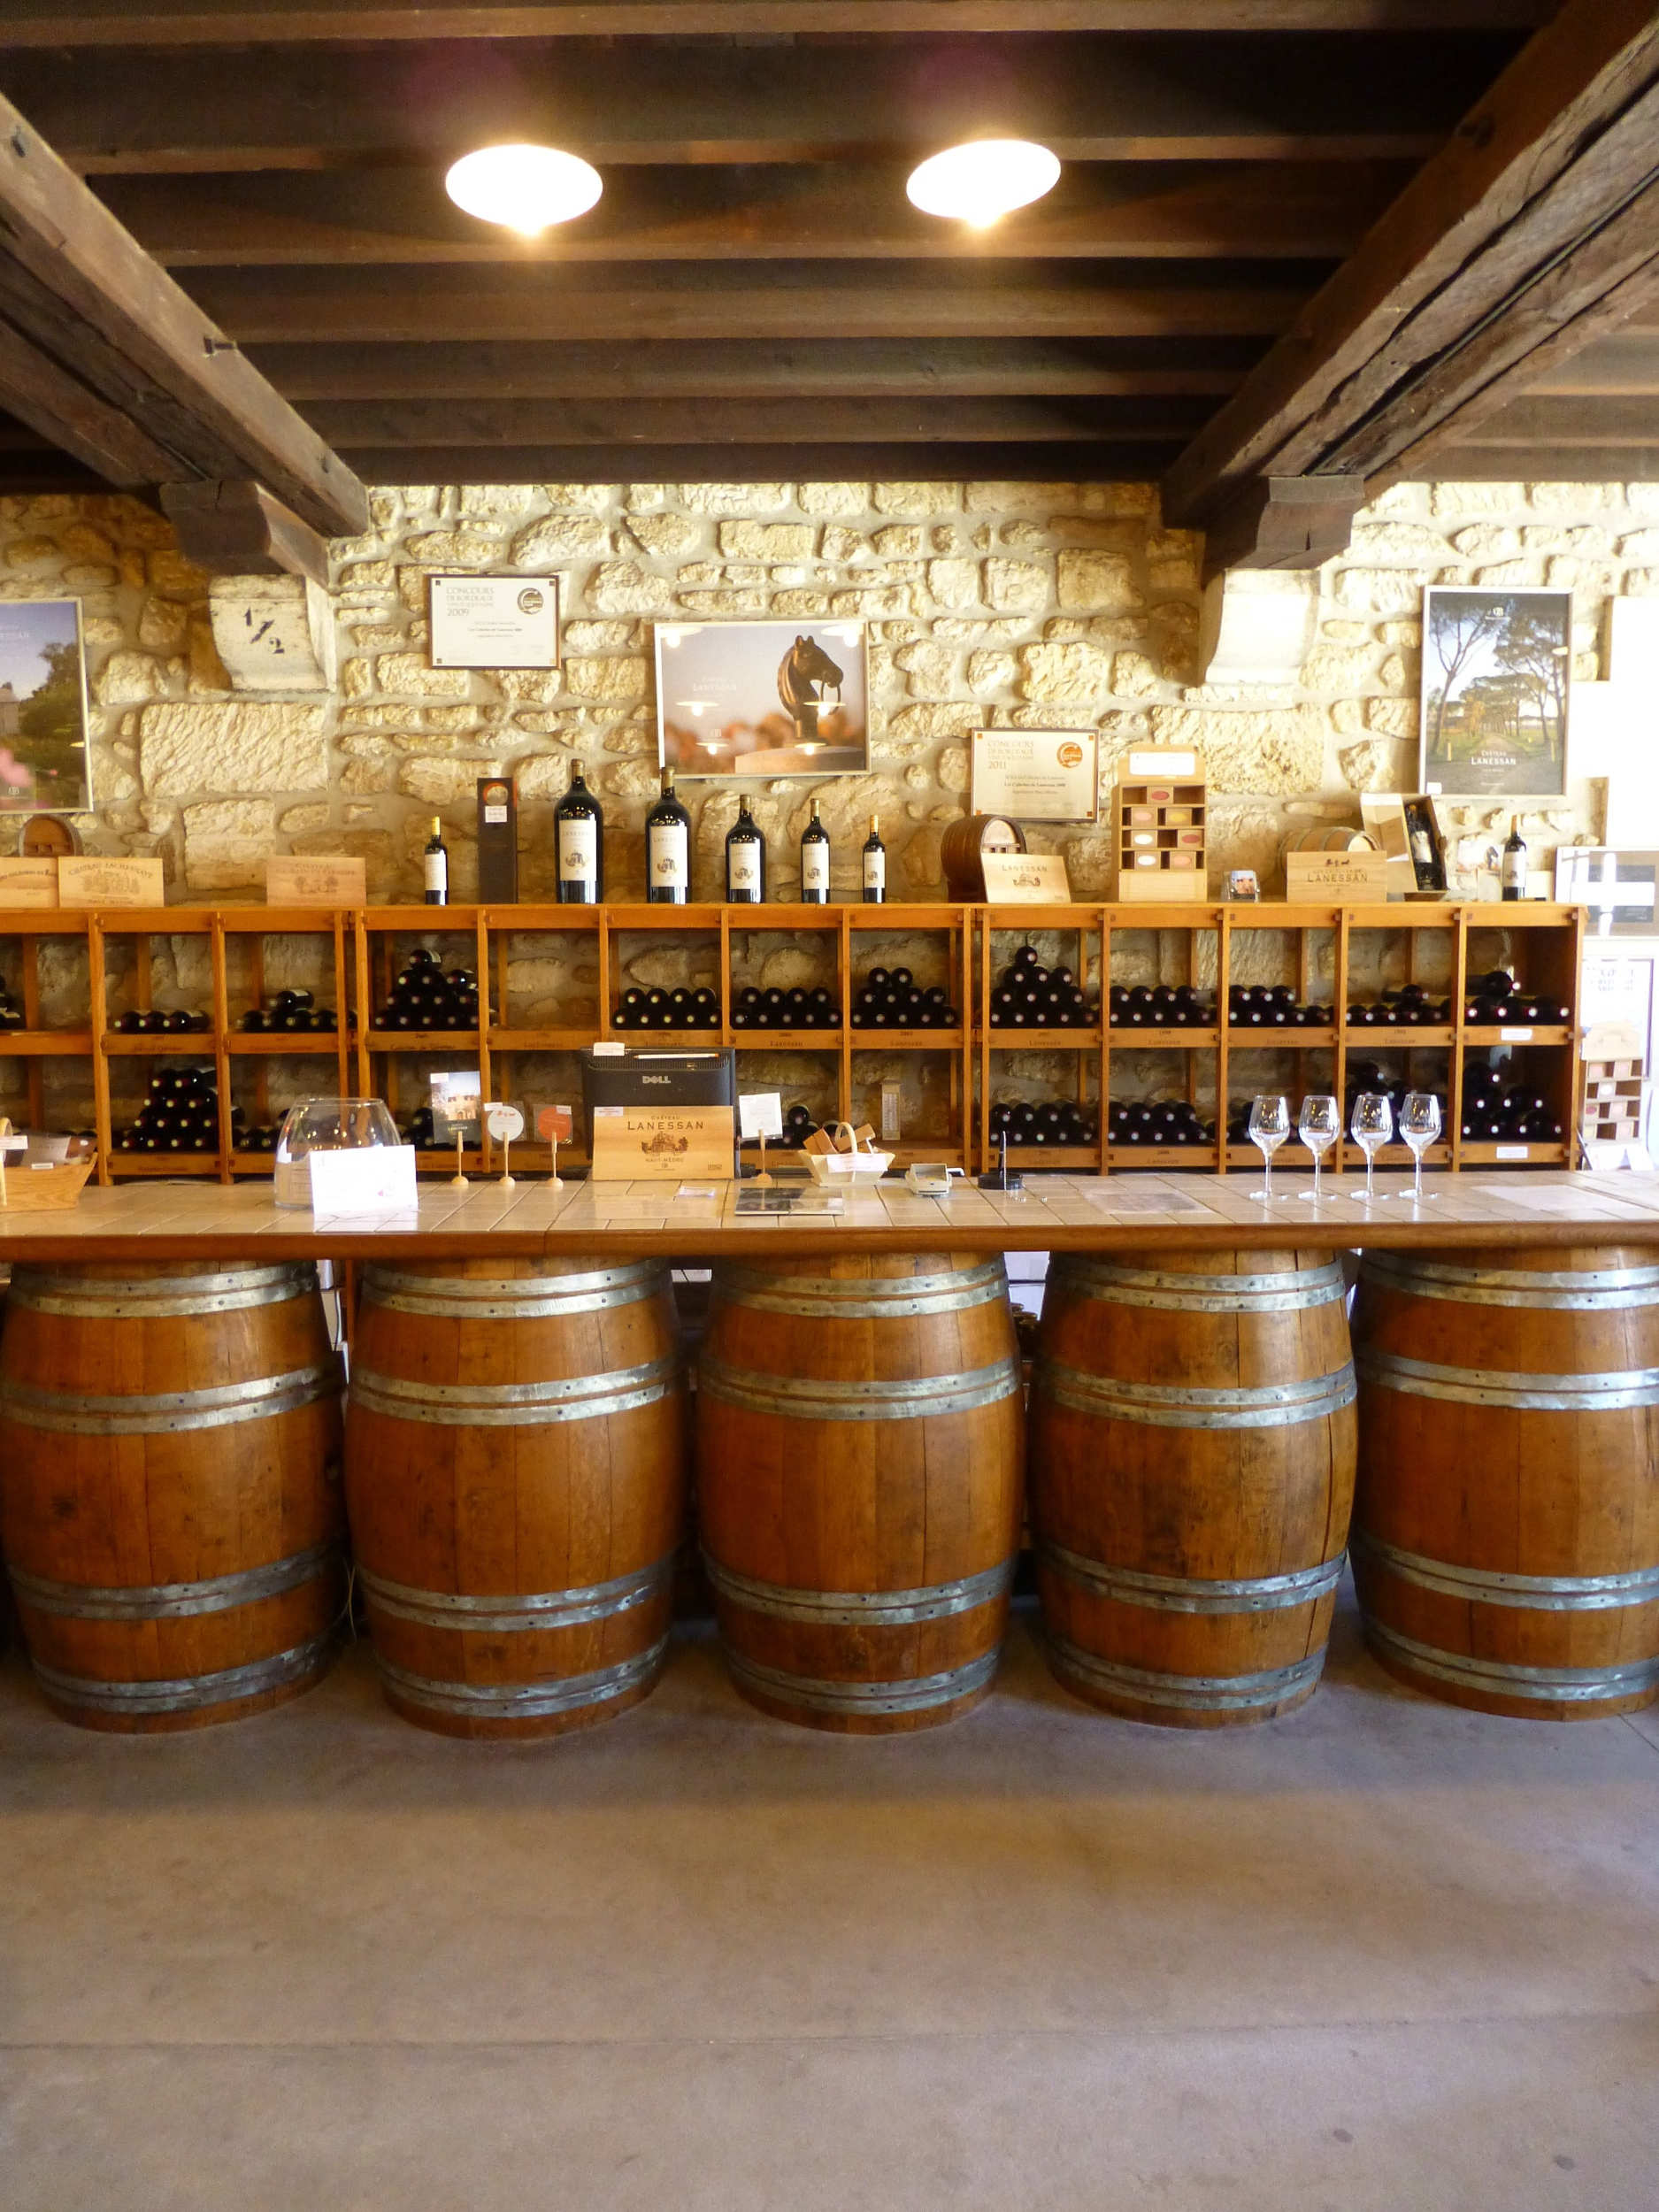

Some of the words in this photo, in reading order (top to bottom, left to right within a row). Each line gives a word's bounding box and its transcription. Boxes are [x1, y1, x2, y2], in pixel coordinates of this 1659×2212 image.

[447, 608, 470, 617] 2009
[1471, 757, 1517, 765] LANESSAN
[1001, 864, 1048, 872] LANESSAN
[1306, 873, 1369, 883] LANESSAN
[641, 1075, 672, 1085] DELL
[626, 1121, 704, 1132] LANESSAN
